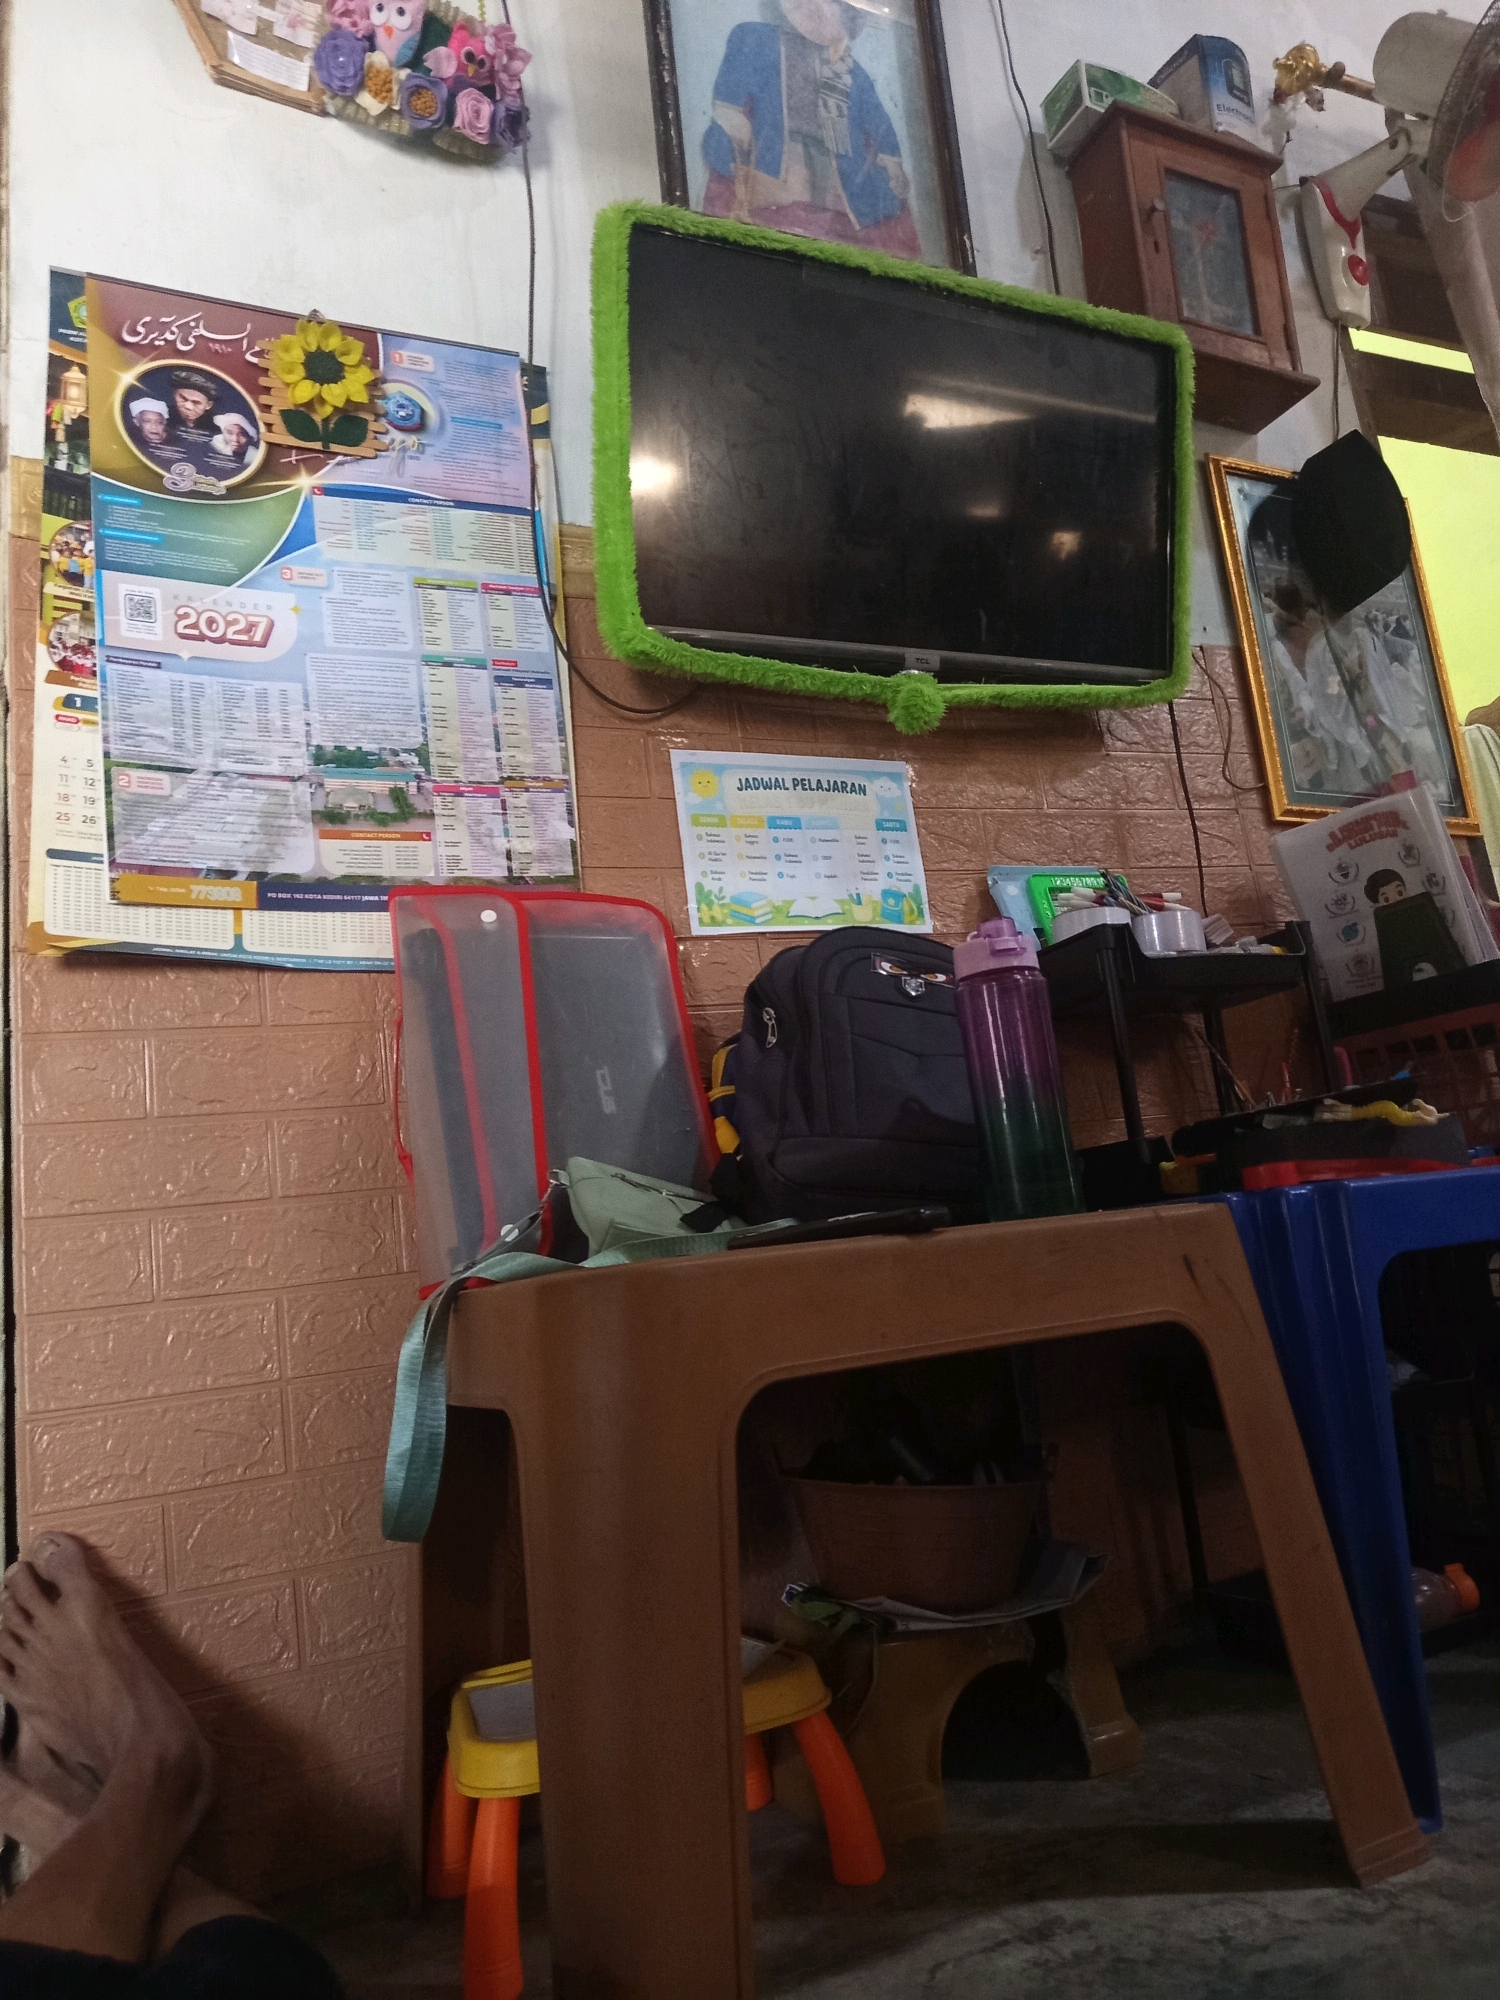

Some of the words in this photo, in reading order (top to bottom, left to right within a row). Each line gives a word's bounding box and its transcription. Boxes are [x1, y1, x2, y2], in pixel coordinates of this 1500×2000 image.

[173, 594, 274, 611] KALENDER
[175, 605, 274, 648] 2027
[915, 657, 931, 665] TCL
[60, 755, 68, 764] 4
[86, 759, 94, 768] 5
[59, 773, 69, 783] 11
[84, 777, 96, 787] 12
[118, 775, 130, 786] 2
[736, 777, 790, 792] JADWAL
[792, 777, 867, 797] PELAJARAN
[57, 792, 70, 802] 18
[83, 795, 96, 806] 19
[56, 812, 71, 822] 25
[82, 815, 97, 825] 26
